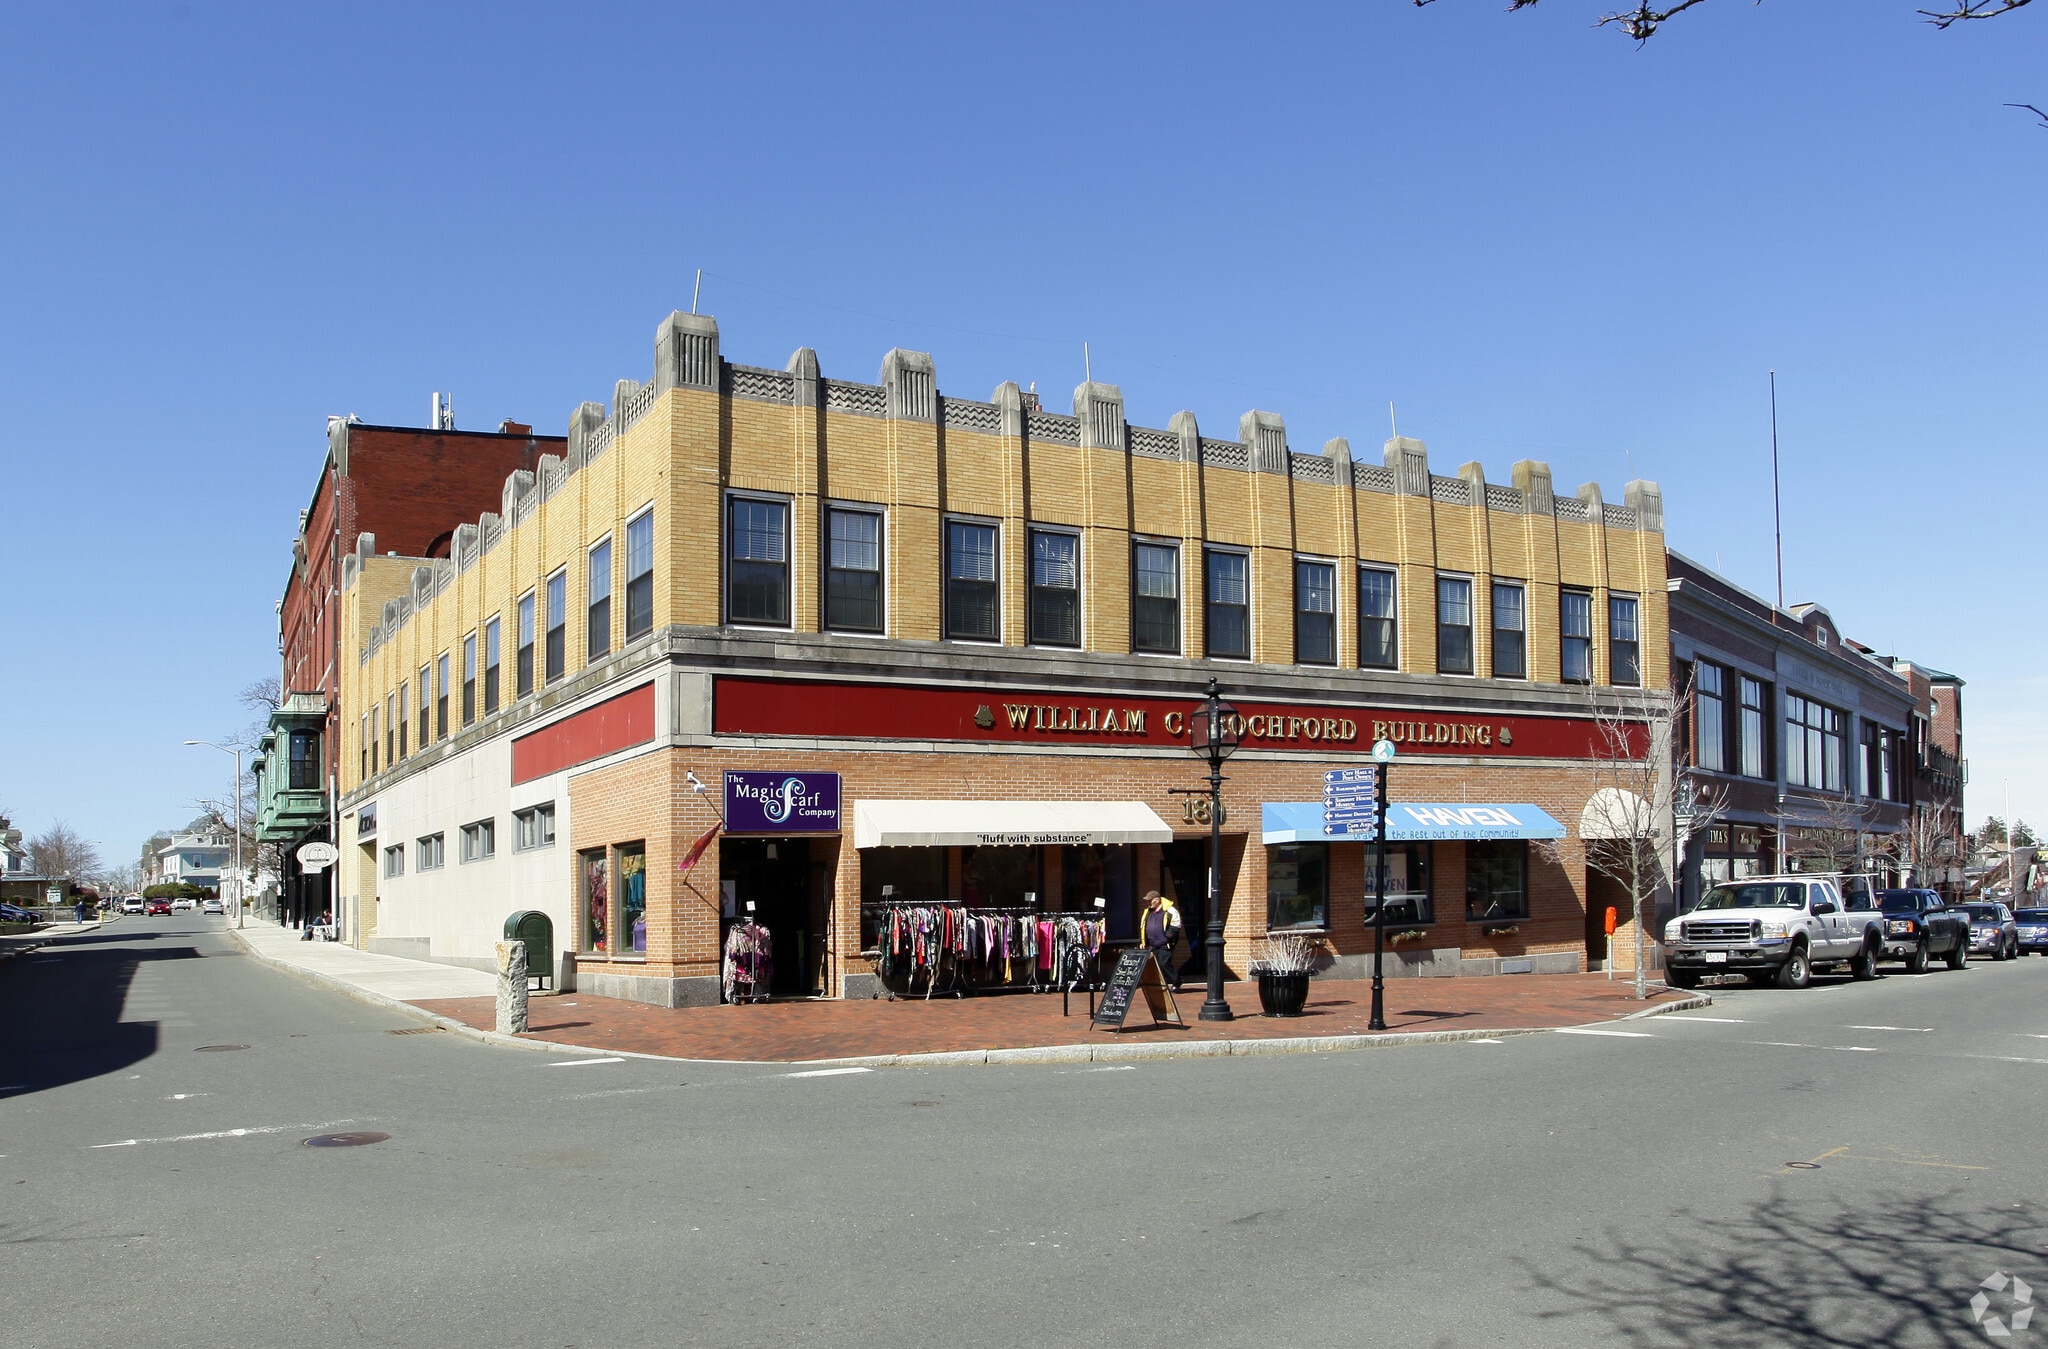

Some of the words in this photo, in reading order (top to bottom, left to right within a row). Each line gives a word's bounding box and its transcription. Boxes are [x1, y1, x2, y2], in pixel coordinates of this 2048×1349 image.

[1003, 703, 1147, 733] WILLIAM
[1372, 719, 1493, 745] BUILDING
[728, 774, 744, 783] The
[736, 782, 784, 803] Magic
[798, 808, 836, 818] Company
[1403, 807, 1523, 826] HAVEN
[977, 834, 1004, 843] "fluff
[1007, 834, 1030, 843] with
[1034, 833, 1091, 843] substance"
[1391, 830, 1406, 839] the
[1432, 830, 1446, 839] out
[1450, 829, 1459, 839] of
[1463, 829, 1476, 839] the
[1366, 879, 1405, 892] HVEN
